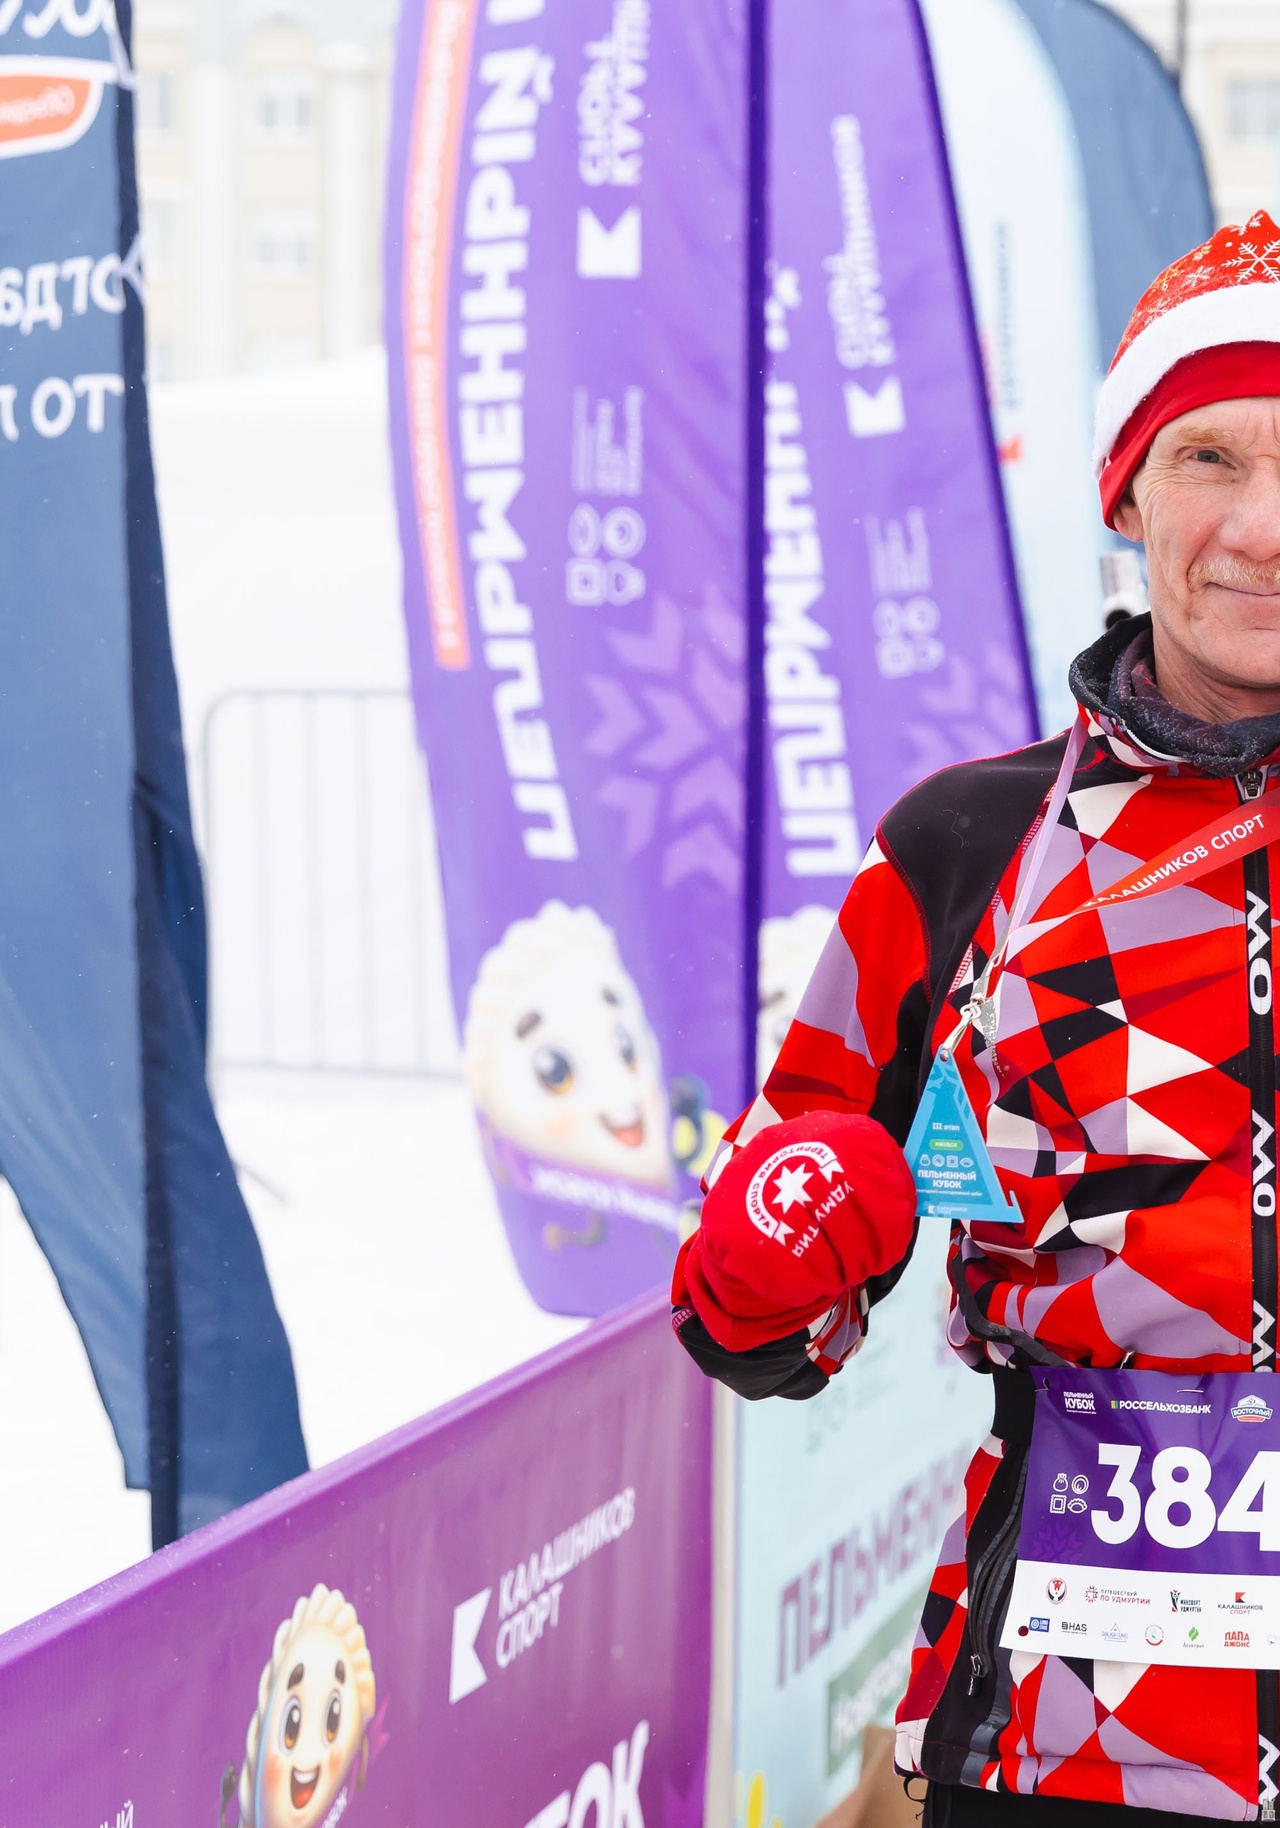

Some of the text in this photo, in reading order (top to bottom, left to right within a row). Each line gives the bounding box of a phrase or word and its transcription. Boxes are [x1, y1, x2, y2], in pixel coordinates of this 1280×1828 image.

[1210, 813, 1266, 849] СПОРТ
[918, 1169, 977, 1181] ПЕЛЬМЕННЫЙ
[749, 1145, 829, 1229] ТЕРРИТОРИЯ СПОРТА
[933, 1180, 962, 1189] КУБОК
[791, 1181, 854, 1258] УДМУТИЯ
[1065, 1398, 1096, 1410] КУБОК
[1119, 1400, 1212, 1414] РОССЕЛЬХОЗБАНК
[1232, 1407, 1271, 1417] ВОСТОЧНЫЙ
[1100, 1594, 1151, 1605] ПО УДМУРТИИ
[1217, 1603, 1263, 1611] КАЛАШНИКОВ
[496, 1581, 564, 1668] СПОРТ
[1069, 1622, 1088, 1632] HAS
[1224, 1631, 1250, 1641] ПАПА
